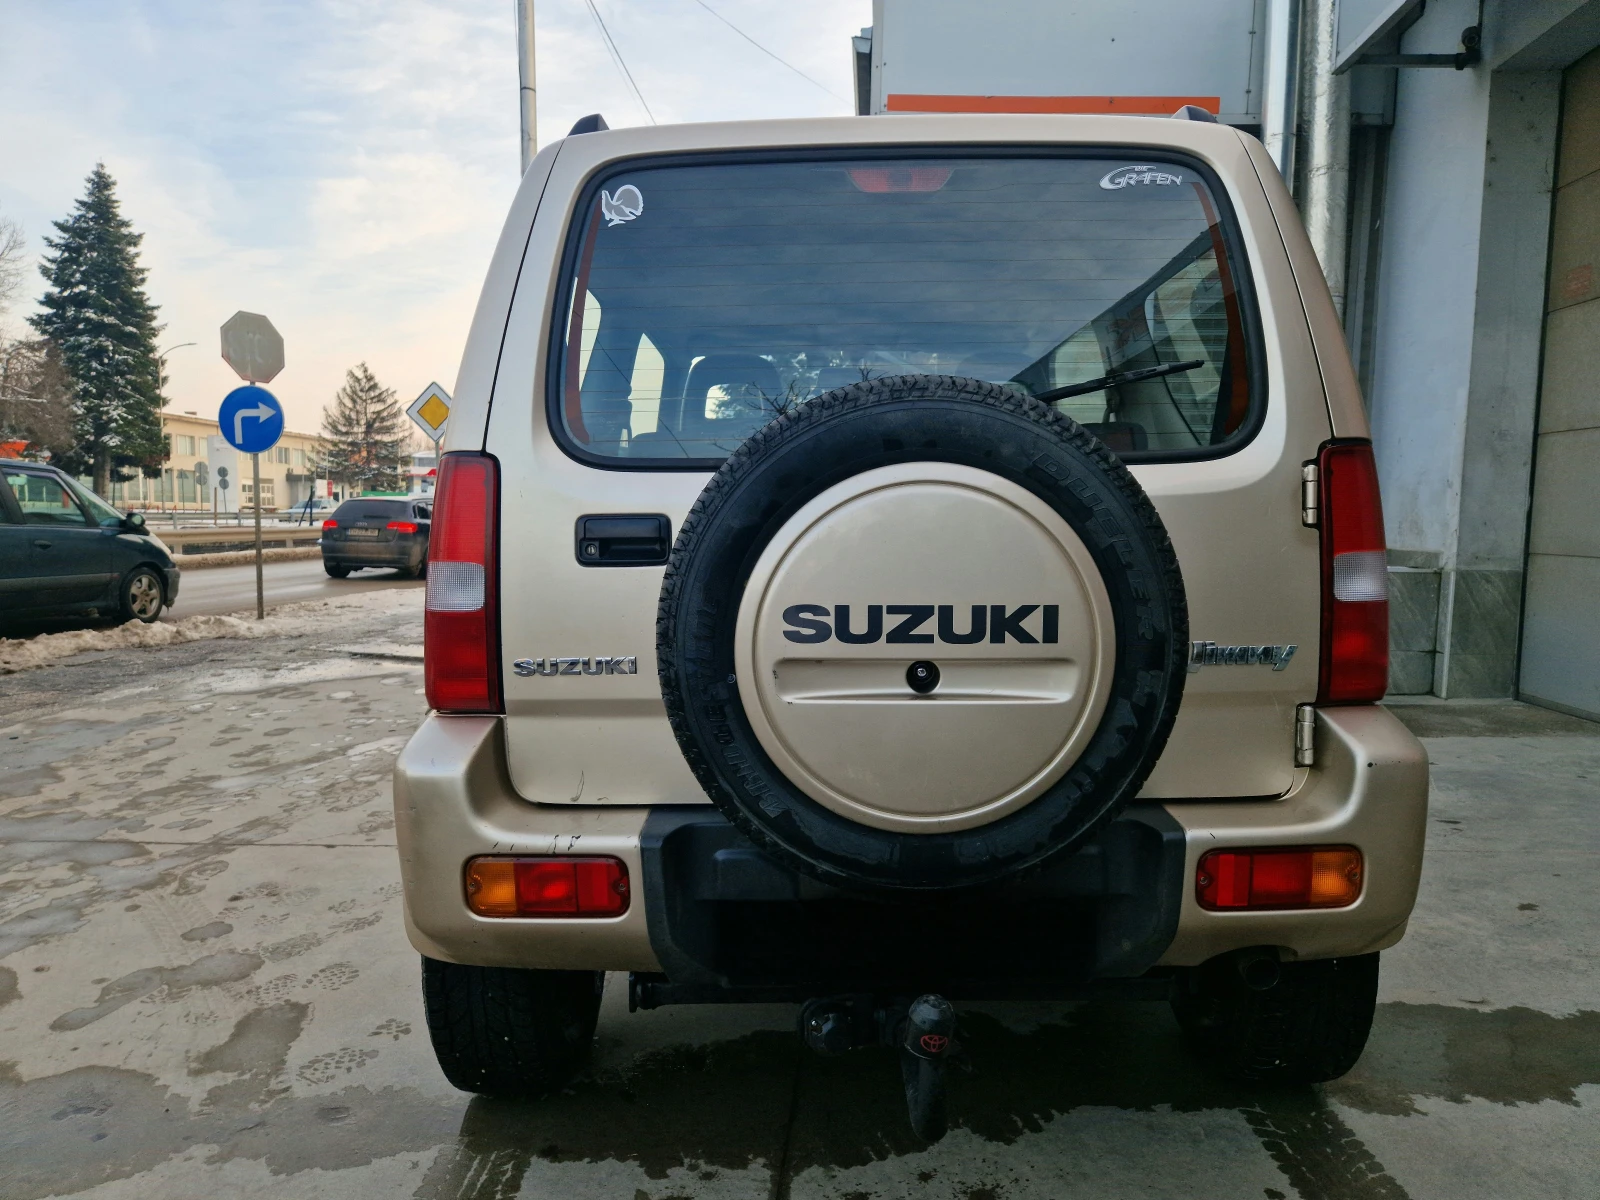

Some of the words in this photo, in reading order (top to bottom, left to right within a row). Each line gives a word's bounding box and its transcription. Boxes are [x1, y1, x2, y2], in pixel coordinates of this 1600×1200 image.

[1032, 453, 1154, 640] DUELER
[782, 604, 1059, 644] SUZUKI
[513, 656, 637, 677] SUZUKI
[1187, 641, 1298, 671] Jimny
